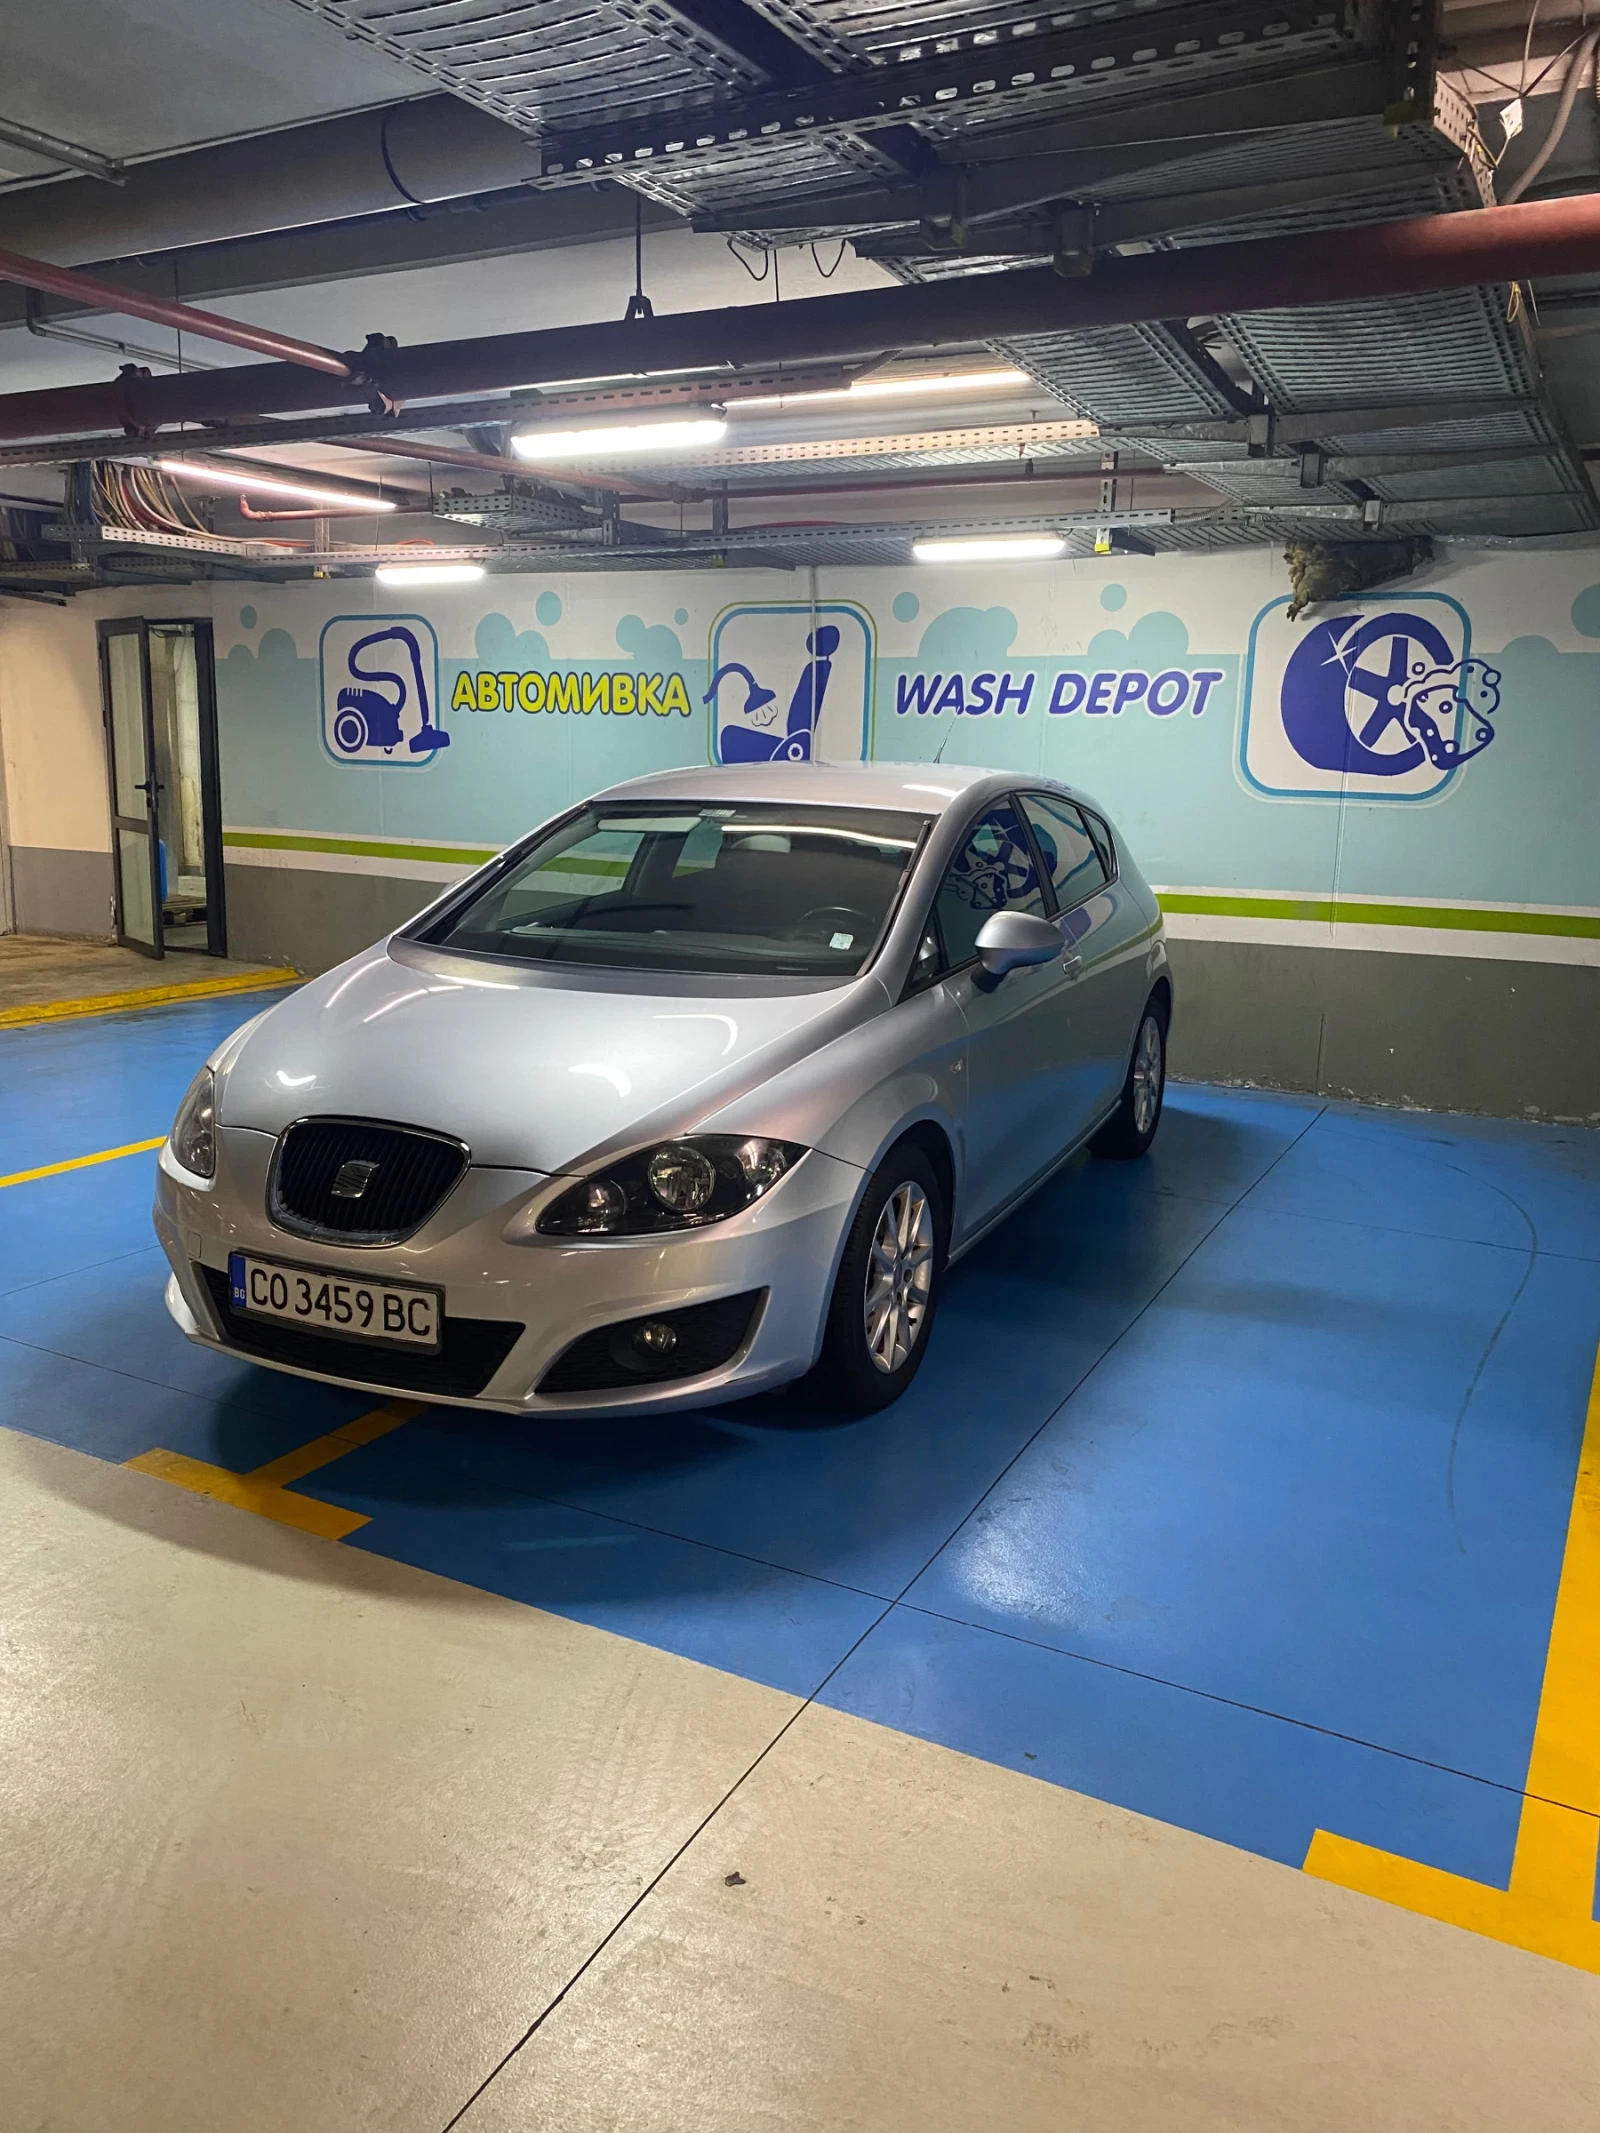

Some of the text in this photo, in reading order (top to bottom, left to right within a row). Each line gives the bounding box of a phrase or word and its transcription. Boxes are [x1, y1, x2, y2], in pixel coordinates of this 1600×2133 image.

[451, 671, 691, 717] АВТОМИВКА
[895, 670, 1224, 717] WASH DEPOT
[233, 1286, 246, 1300] BG
[295, 1278, 374, 1328] 3459
